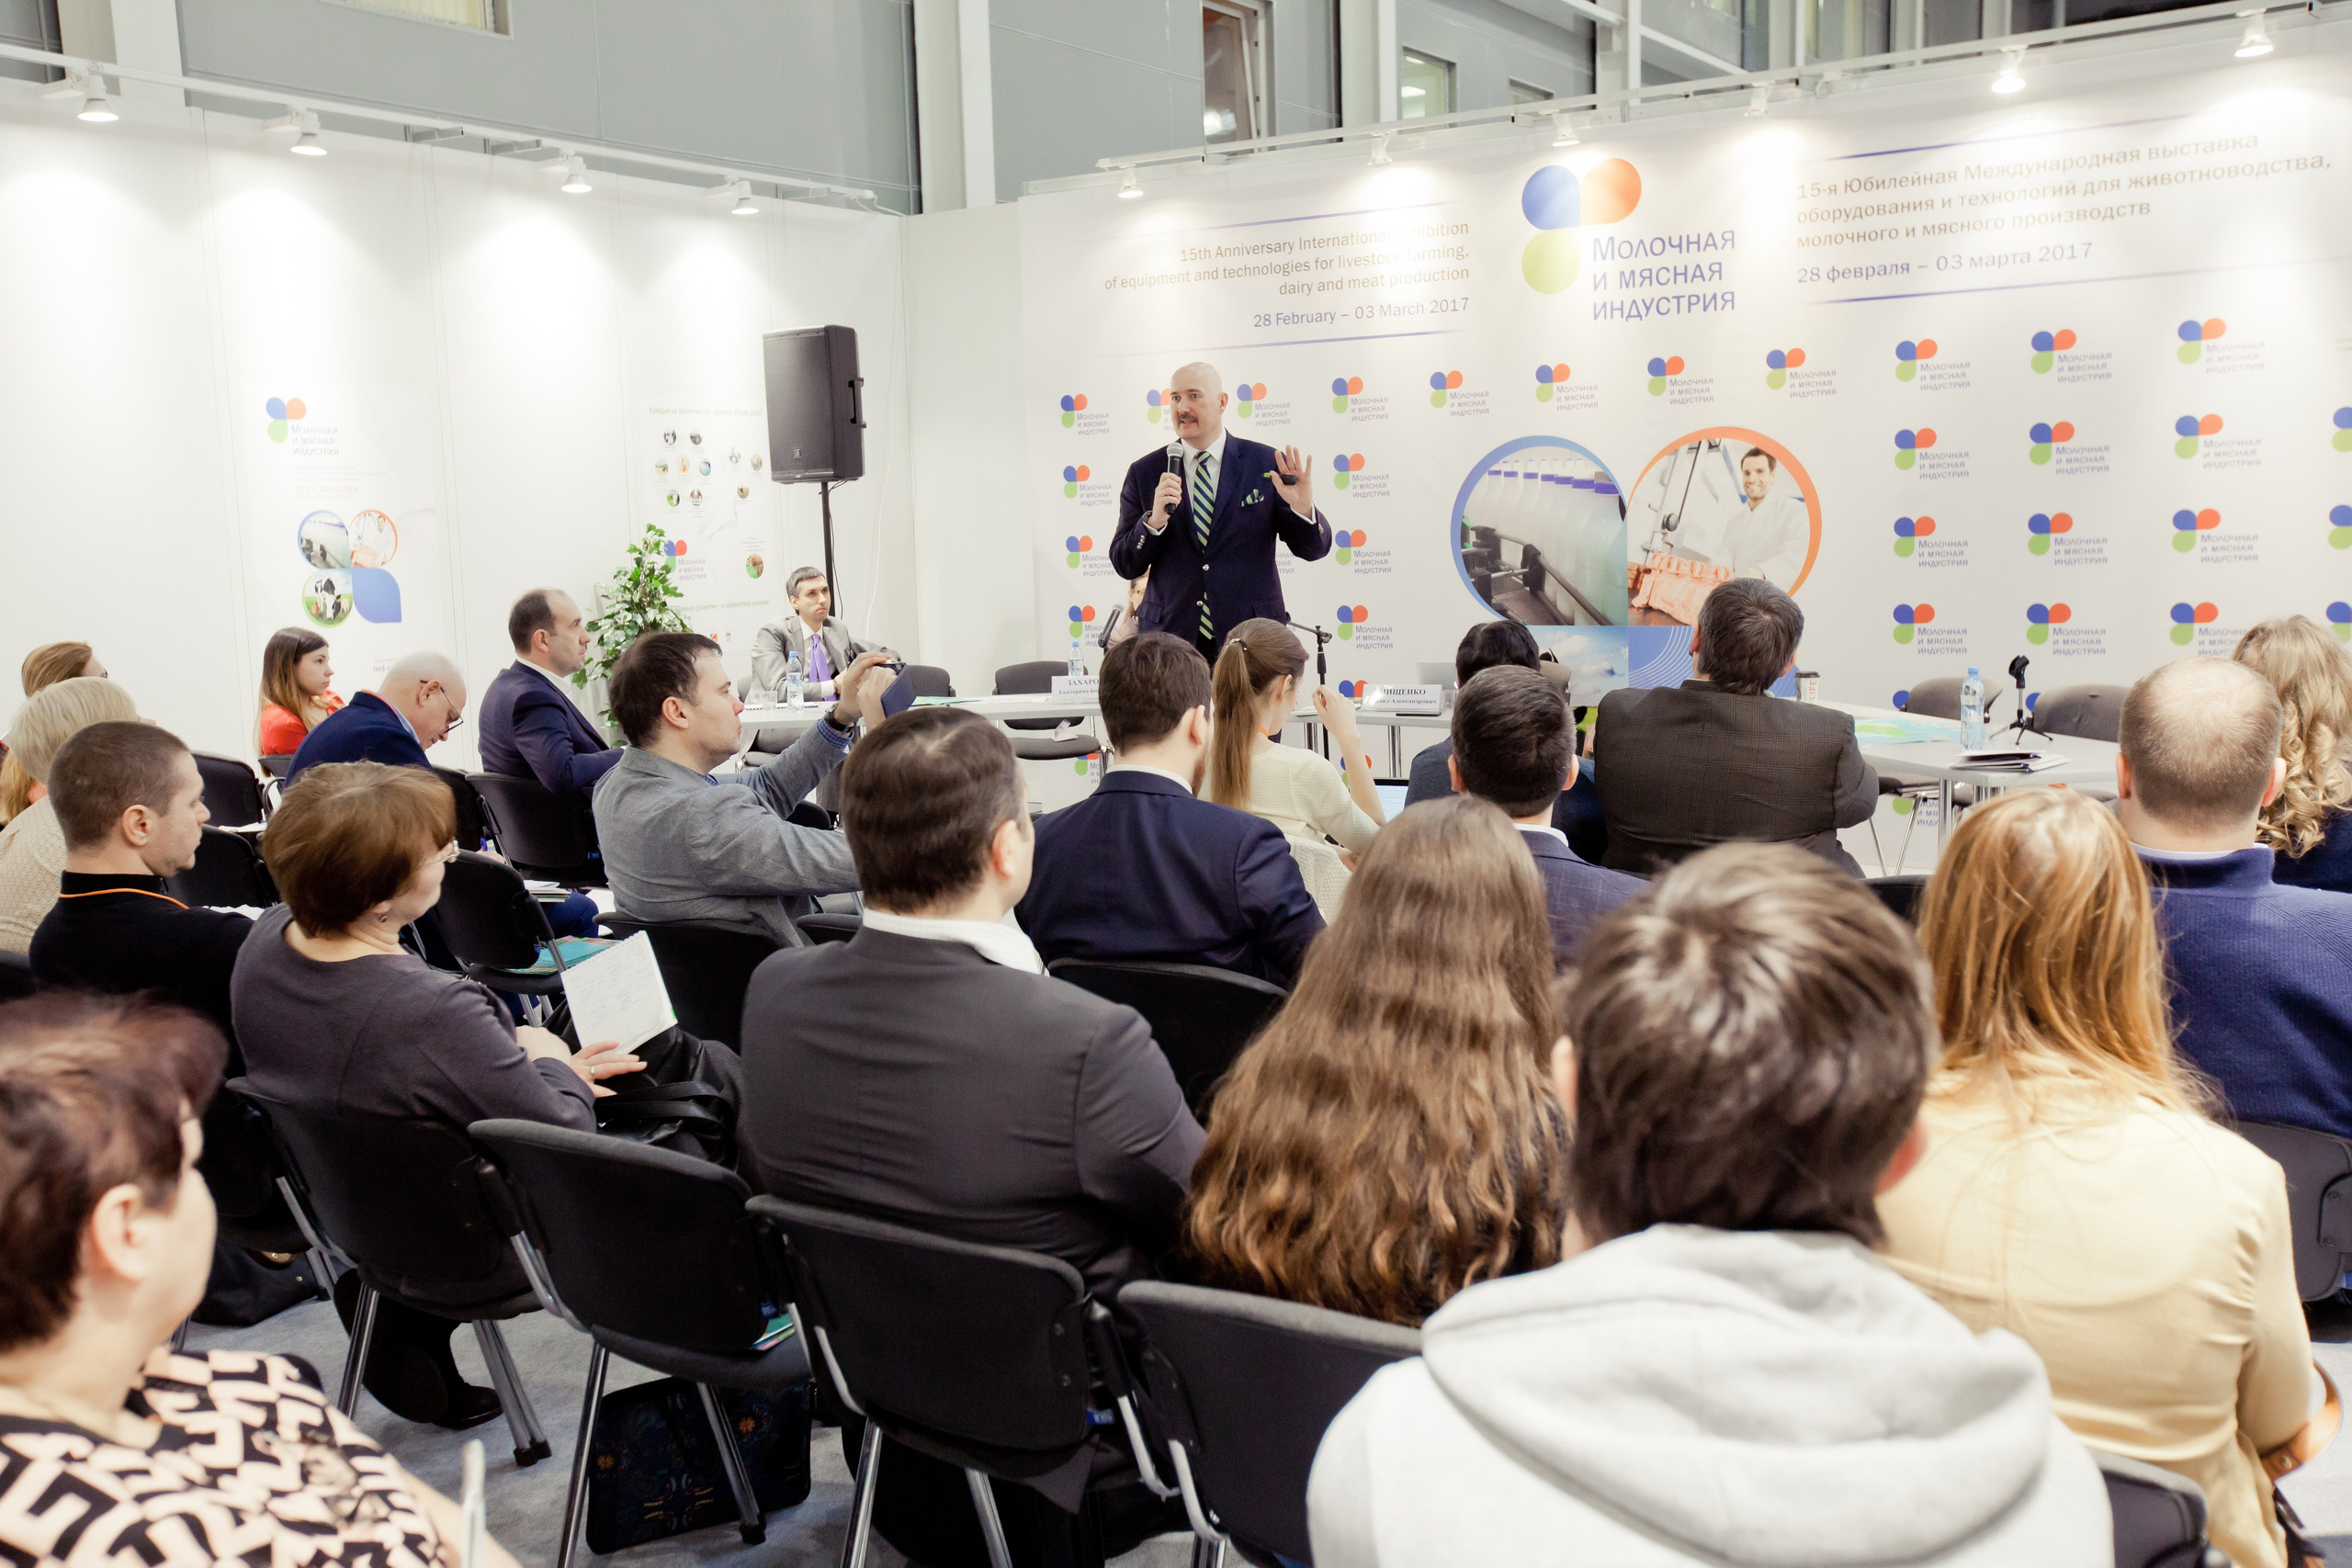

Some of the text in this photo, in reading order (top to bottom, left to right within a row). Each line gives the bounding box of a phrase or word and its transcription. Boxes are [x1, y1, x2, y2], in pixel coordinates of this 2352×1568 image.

[1797, 134, 2258, 199] 15-я Юбилейная Международная выставка
[1797, 154, 2331, 224] оборудования и технологий для животноводства,
[1797, 202, 2151, 249] молочного и мясного производств
[1180, 247, 1212, 262] 15th
[1216, 241, 1295, 258] Anniversary
[1299, 230, 1390, 250] International
[1797, 267, 1820, 283] 28
[1826, 262, 1910, 284] февраля
[1936, 254, 1962, 271] 03
[1970, 251, 2030, 269] марта
[2038, 242, 2093, 262] 2017
[1104, 276, 1117, 290] of
[1120, 270, 1190, 290] equipment
[1194, 267, 1219, 282] and
[1223, 258, 1311, 278] technologies
[1315, 257, 1334, 270] for
[1339, 250, 1401, 268] livestock
[1279, 266, 1469, 296] dairy and meat production
[1253, 313, 1272, 327] 28
[1276, 310, 1337, 326] February
[1354, 305, 1374, 320] 03
[1379, 301, 1424, 318] March
[1430, 297, 1469, 313] 2017
[1809, 680, 1817, 700] LIFE
